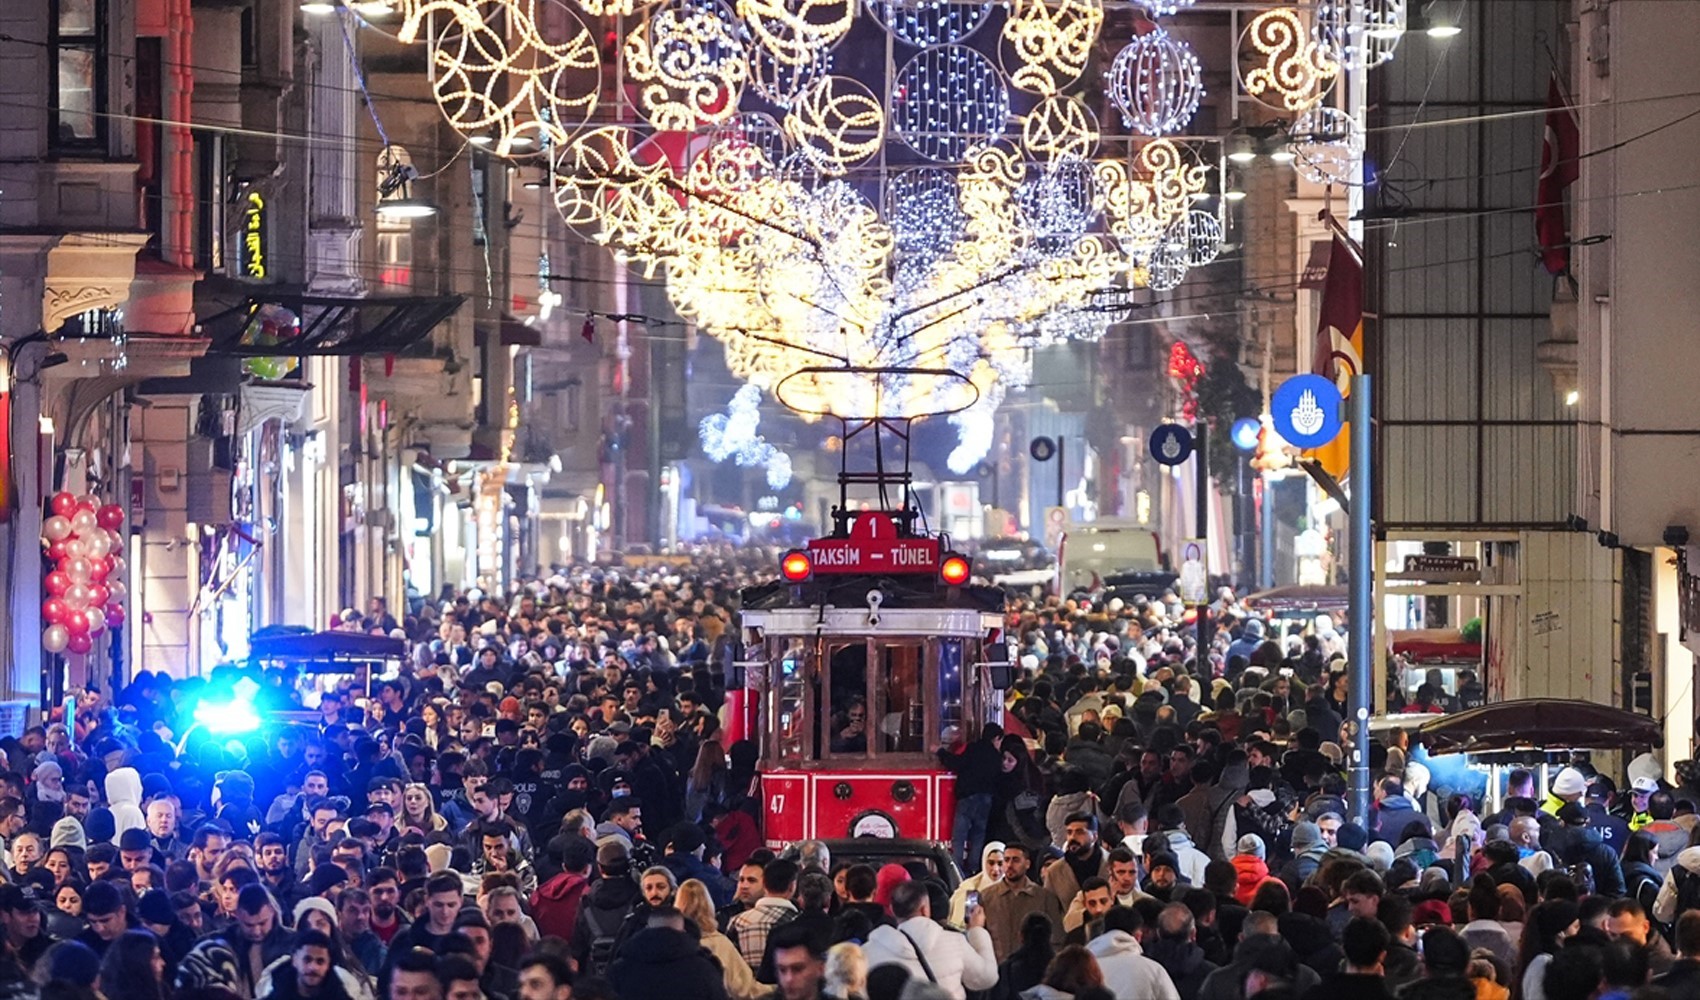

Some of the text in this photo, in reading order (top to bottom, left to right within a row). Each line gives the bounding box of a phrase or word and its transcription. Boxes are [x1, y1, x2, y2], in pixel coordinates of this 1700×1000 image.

[869, 517, 876, 538] 1
[812, 544, 860, 565] TAKSİM
[891, 544, 933, 565] TÜNEL
[770, 794, 785, 814] 47
